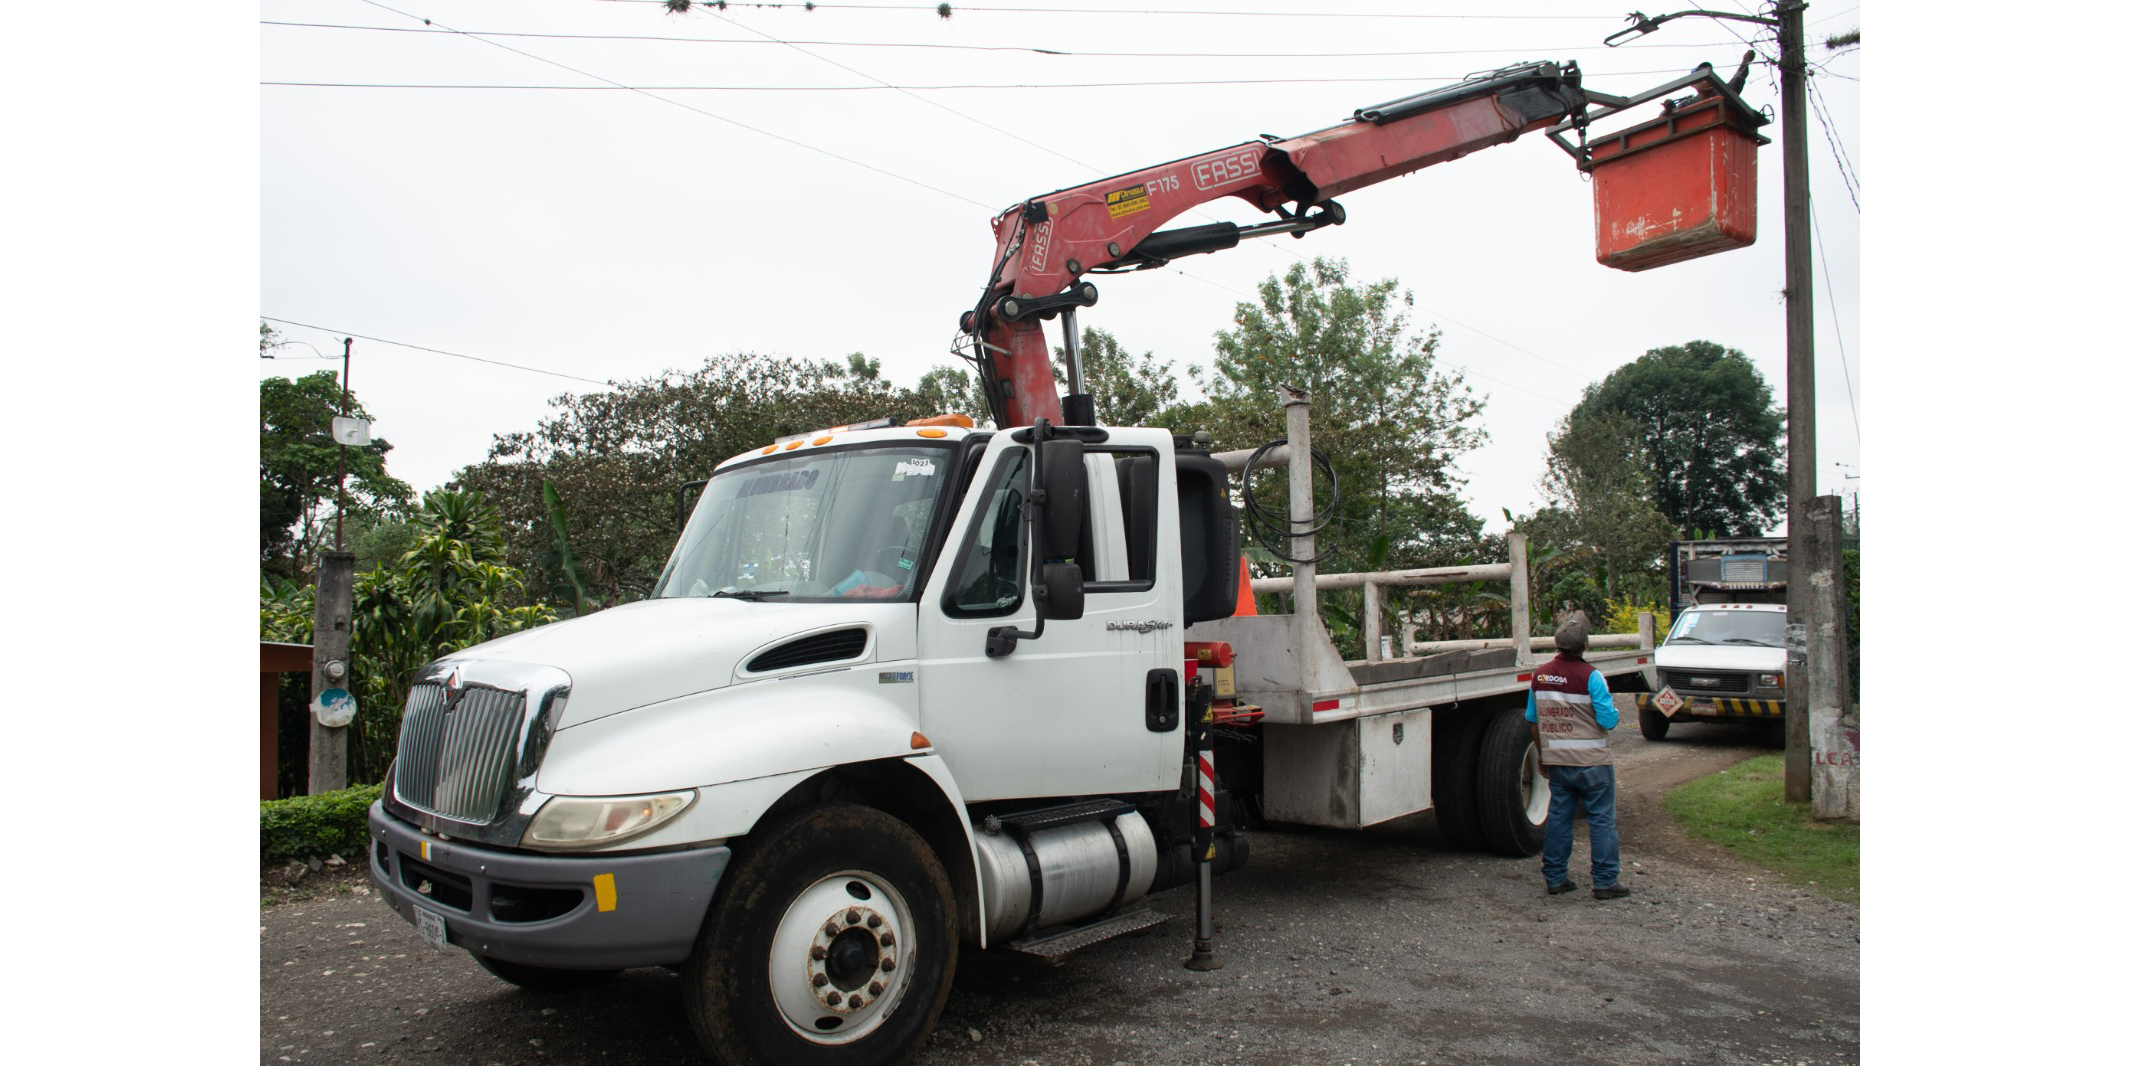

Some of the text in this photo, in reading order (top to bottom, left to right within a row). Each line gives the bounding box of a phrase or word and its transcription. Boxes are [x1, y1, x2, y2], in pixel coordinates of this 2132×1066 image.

[1197, 151, 1261, 186] FASSI
[1146, 175, 1180, 196] F175
[1539, 706, 1574, 718] ALUMBRADO
[1541, 720, 1573, 733] PÚBLICO
